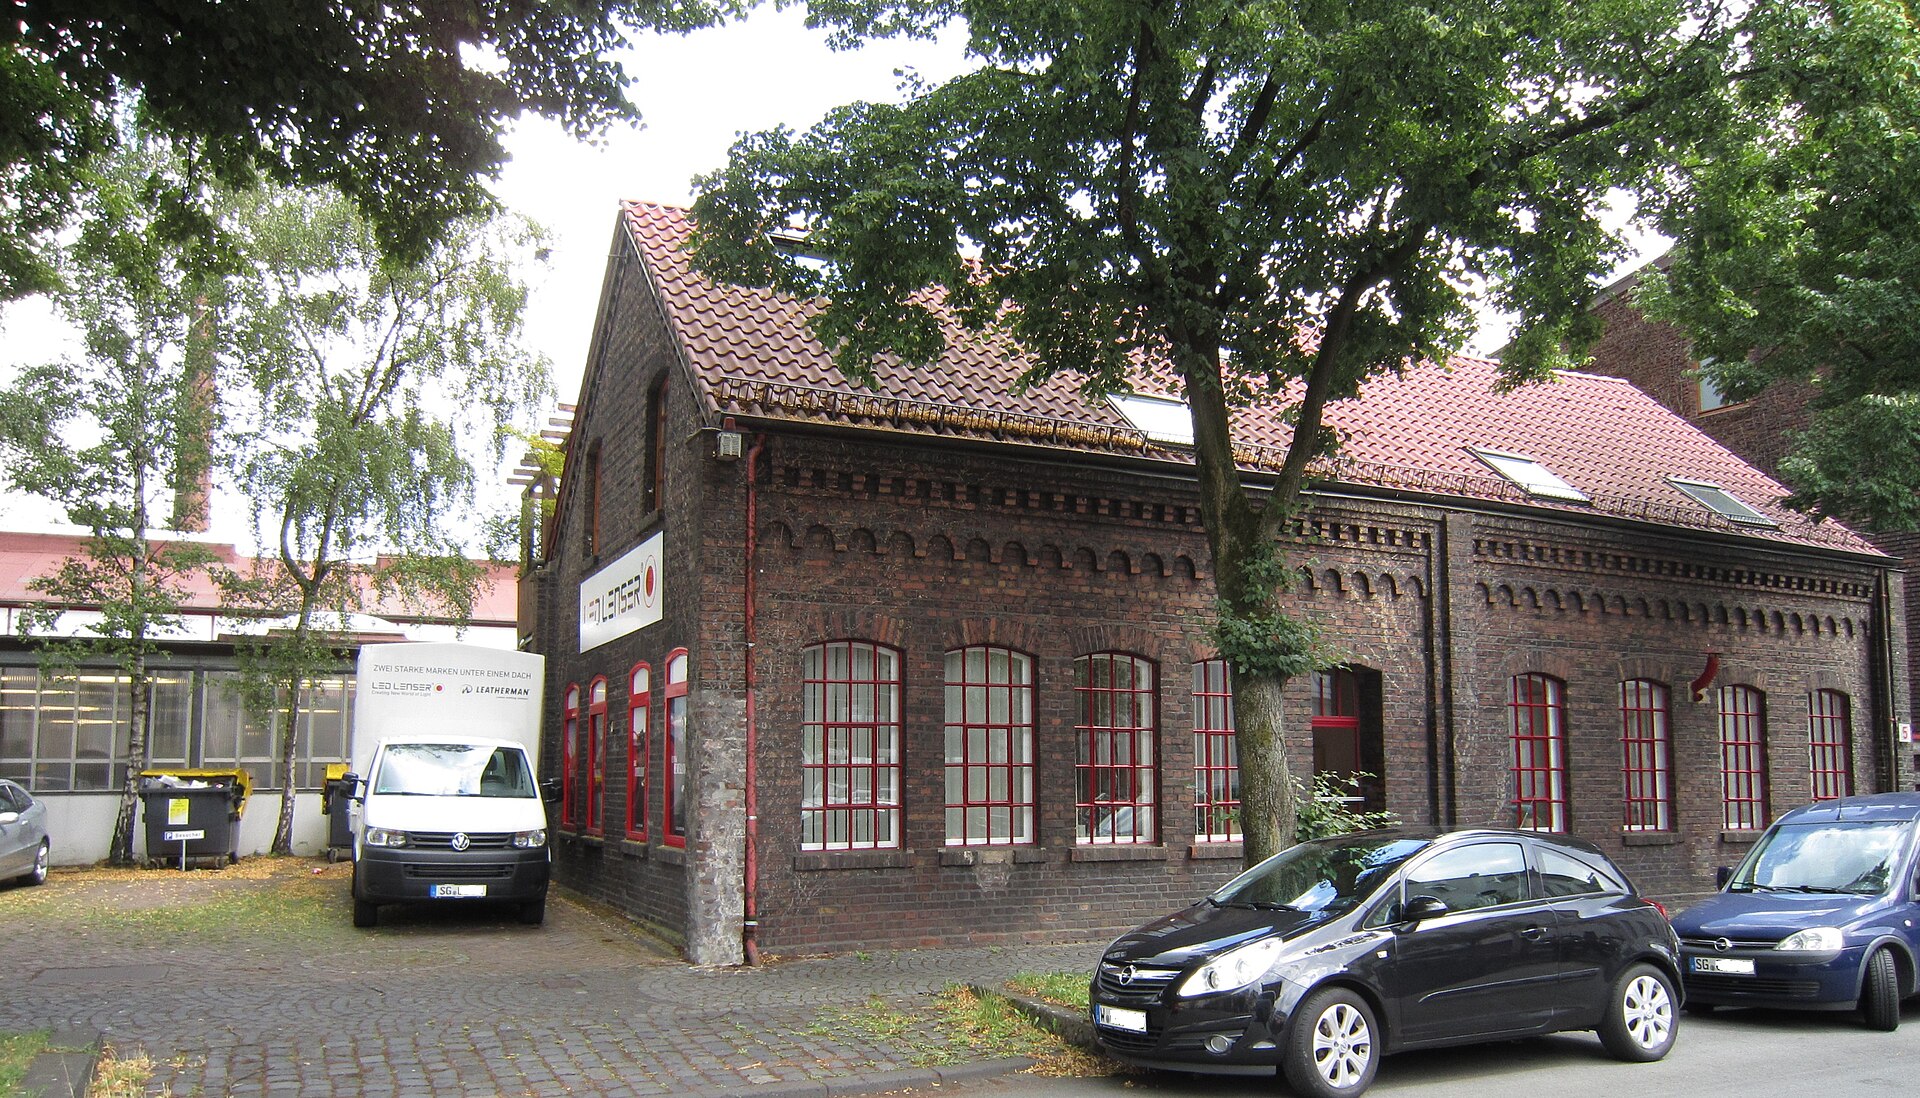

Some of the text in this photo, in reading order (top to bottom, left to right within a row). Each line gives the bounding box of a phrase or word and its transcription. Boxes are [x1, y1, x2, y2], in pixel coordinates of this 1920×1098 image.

[373, 664, 532, 680] ZWEI STARKE MARKEN UNTER EINEM DACH
[372, 682, 391, 690] LED
[476, 686, 530, 696] LEATHERMAN
[1902, 726, 1908, 739] 5
